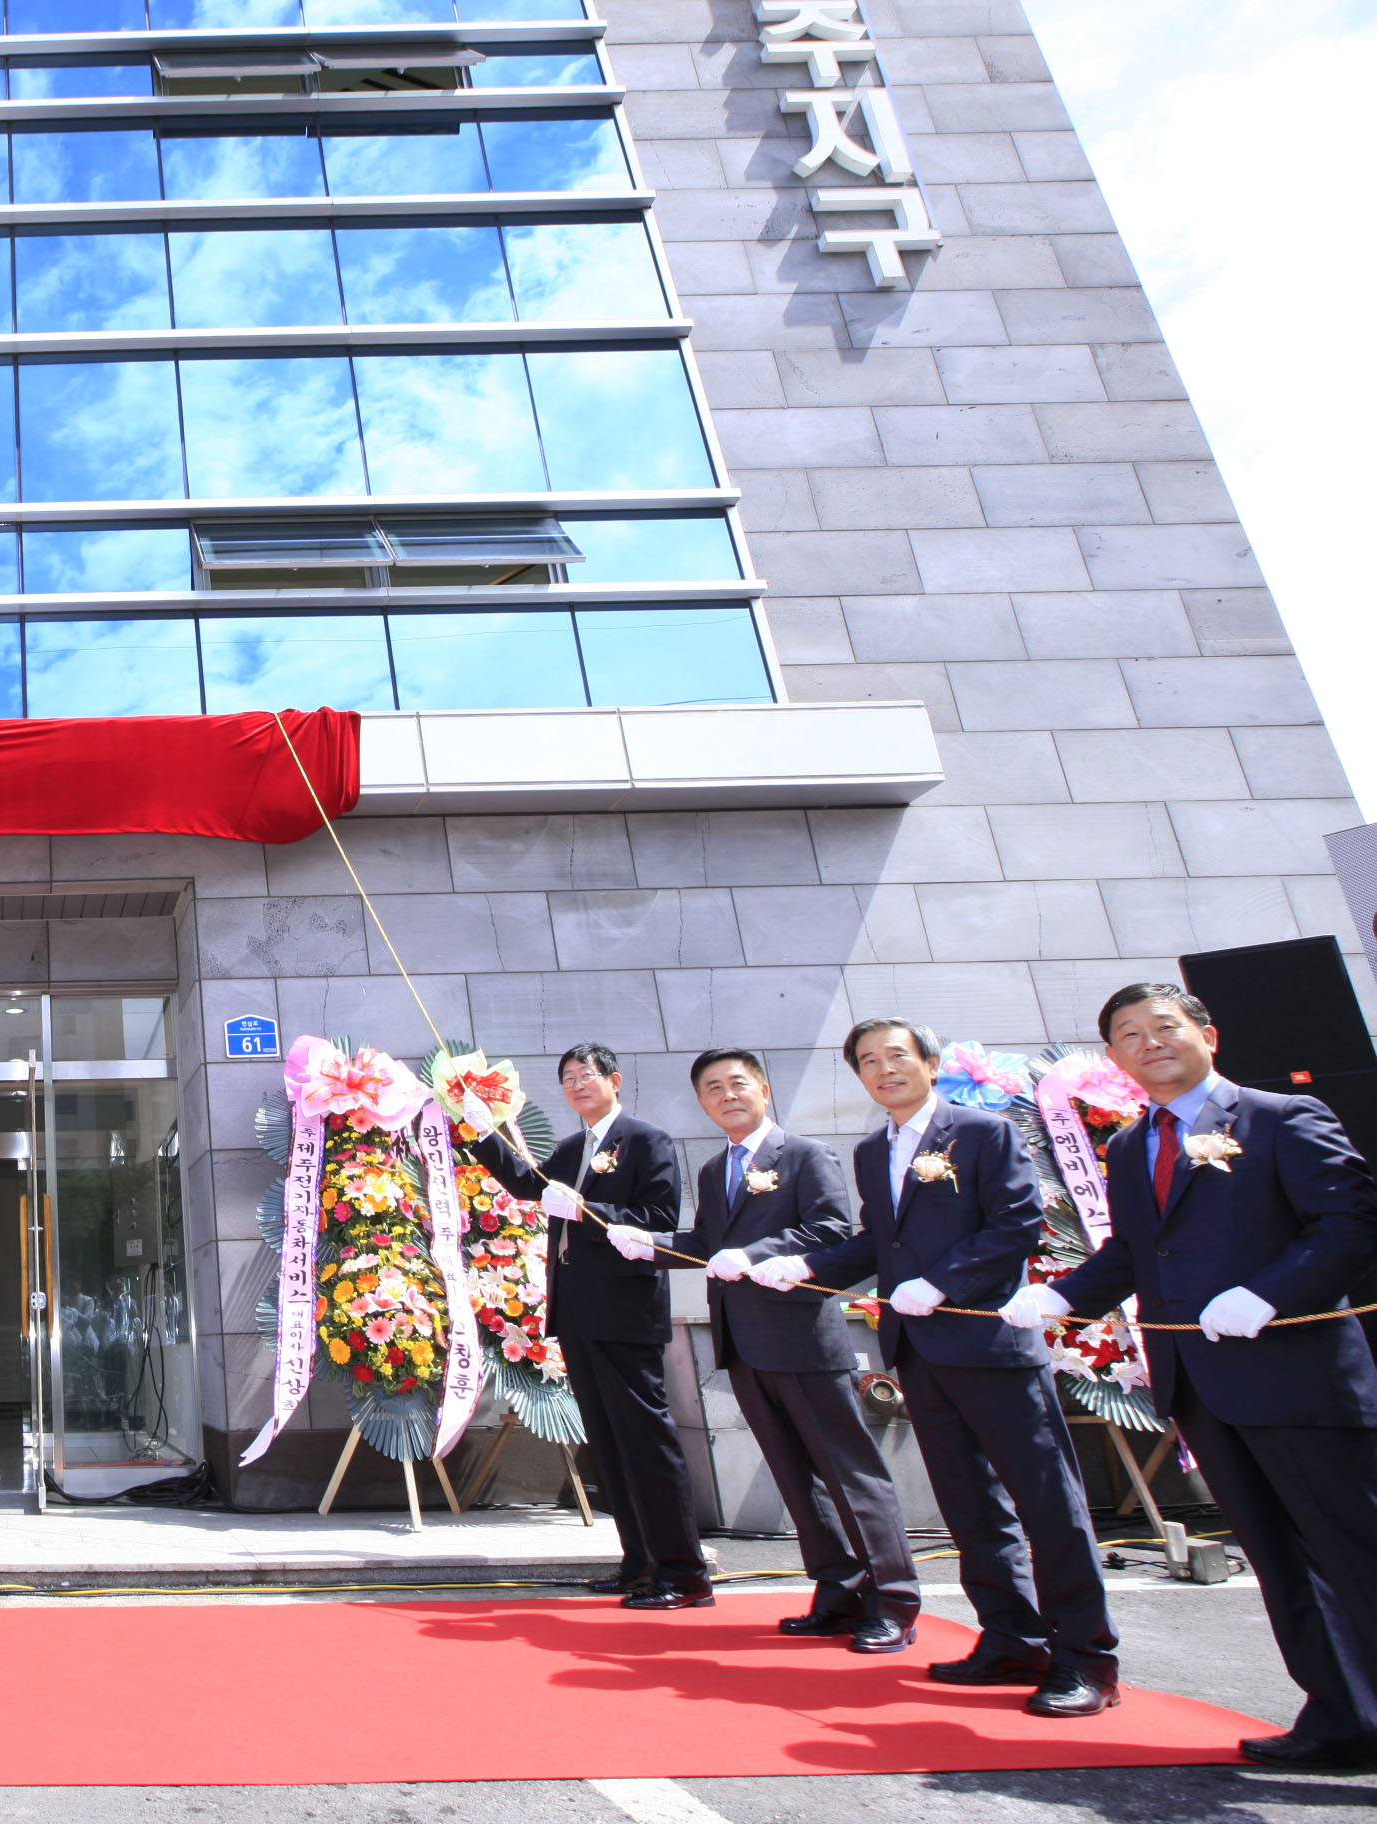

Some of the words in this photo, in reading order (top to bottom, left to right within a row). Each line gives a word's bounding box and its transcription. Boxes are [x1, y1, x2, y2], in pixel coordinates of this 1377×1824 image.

[242, 1036, 262, 1053] 61
[287, 1124, 318, 1303] (주)제주전기자동차서비스
[289, 1310, 305, 1352] 대표이사
